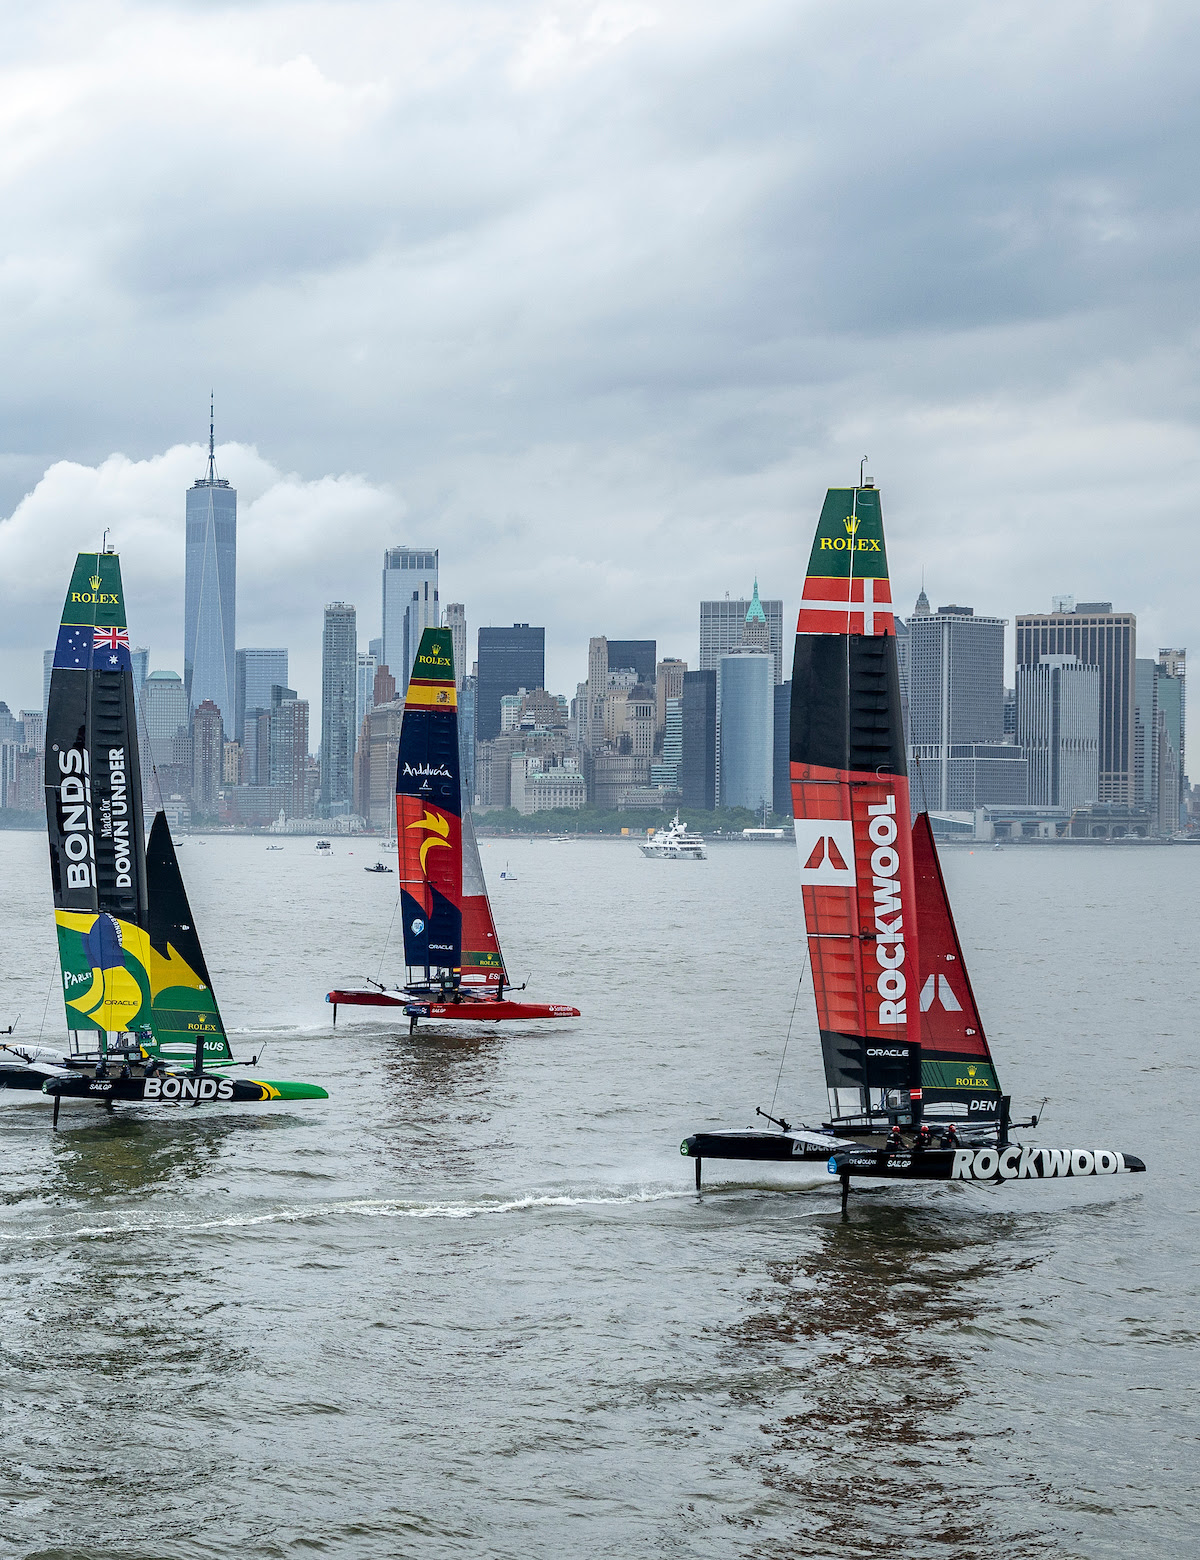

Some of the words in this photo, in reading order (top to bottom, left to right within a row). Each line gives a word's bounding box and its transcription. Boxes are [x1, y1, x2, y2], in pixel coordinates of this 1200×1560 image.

[820, 538, 881, 551] ROLEX
[72, 592, 119, 604] ROLEX
[419, 656, 451, 666] ROLEX
[109, 748, 128, 815] UNDER
[100, 799, 111, 811] for
[59, 749, 90, 889] BONDS
[101, 812, 112, 837] Made
[114, 821, 131, 888] DOWN
[868, 795, 907, 1025] ROCKWOOL
[64, 971, 92, 989] PARLEY
[203, 1042, 224, 1051] AUS
[866, 1048, 909, 1056] ORACLE
[144, 1079, 234, 1098] BONDS
[956, 1078, 988, 1086] ROLEX
[970, 1100, 997, 1111] DEN
[951, 1147, 1131, 1179] ROCKWOOL
